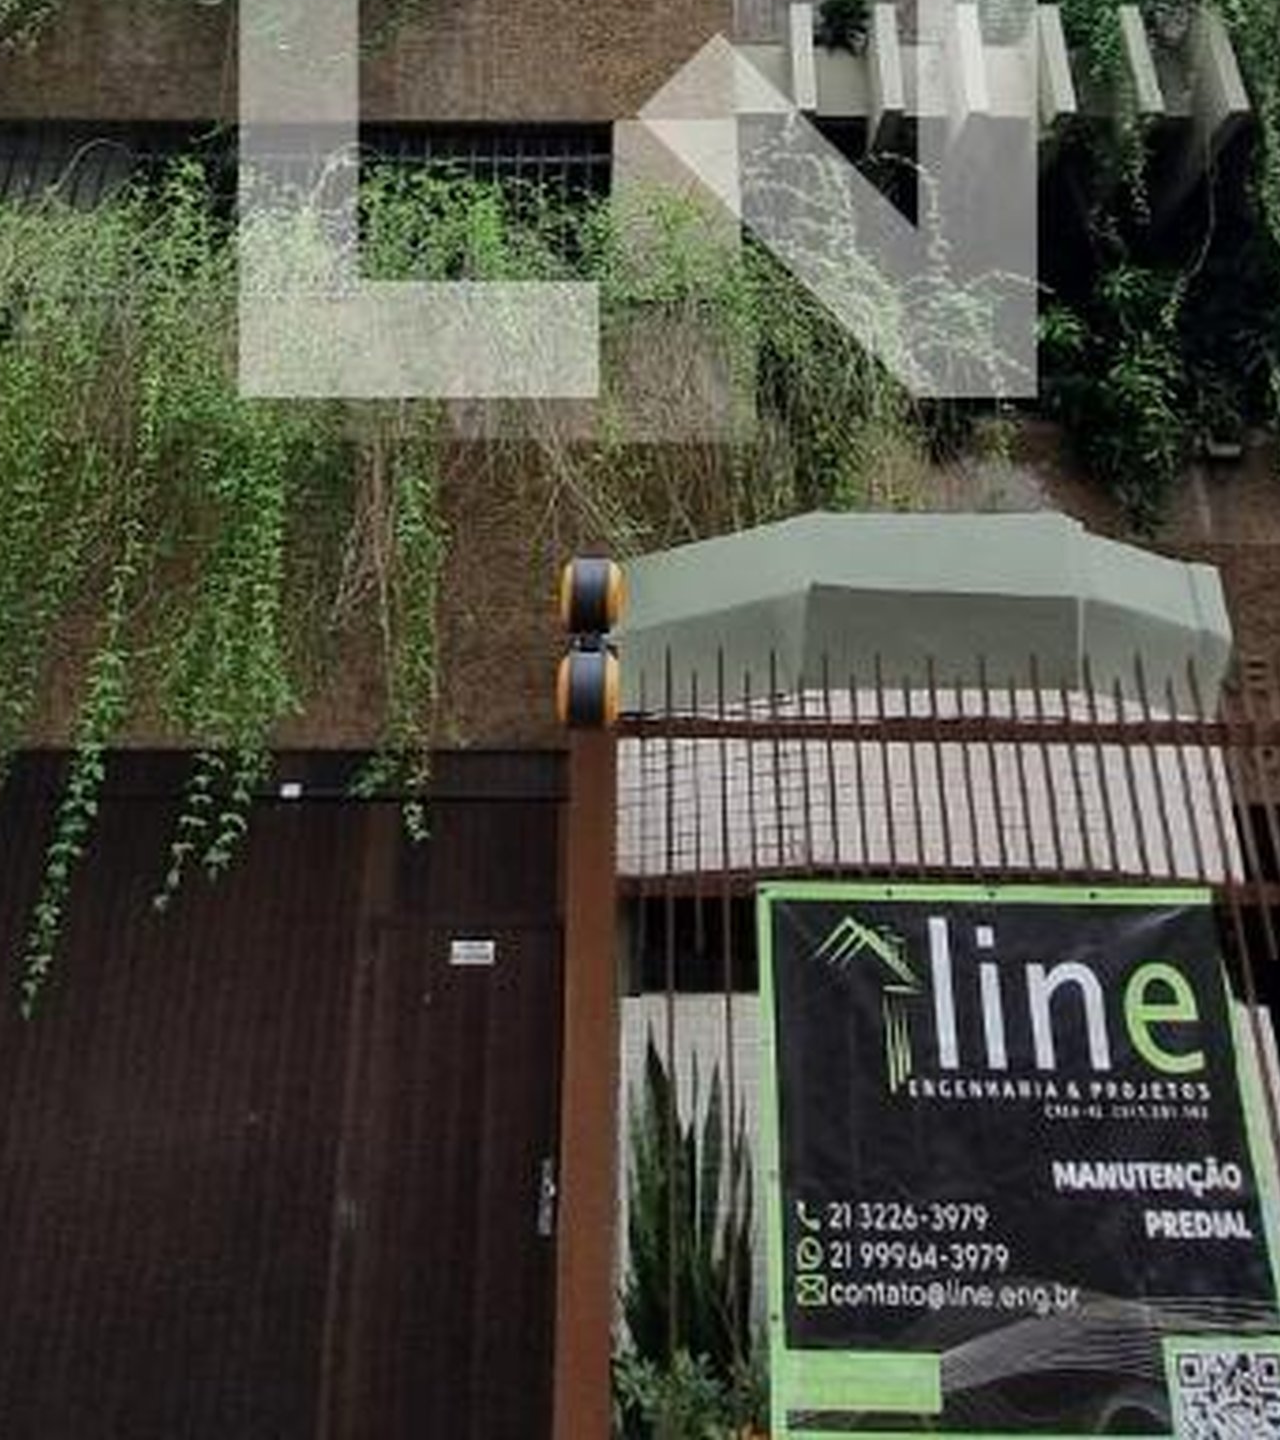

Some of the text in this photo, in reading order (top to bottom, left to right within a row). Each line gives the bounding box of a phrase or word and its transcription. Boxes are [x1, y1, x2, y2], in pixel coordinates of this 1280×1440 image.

[928, 916, 1206, 1073] line
[1090, 1081, 1211, 1100] PROJETOS
[1052, 1157, 1242, 1197] MANUTENÇÃO
[829, 1203, 989, 1231] 21 3226-3979
[1145, 1210, 1252, 1239] PREDIAL
[830, 1241, 1009, 1272] 21 99964-3979
[830, 1280, 1078, 1314] contato@line.eng.br
